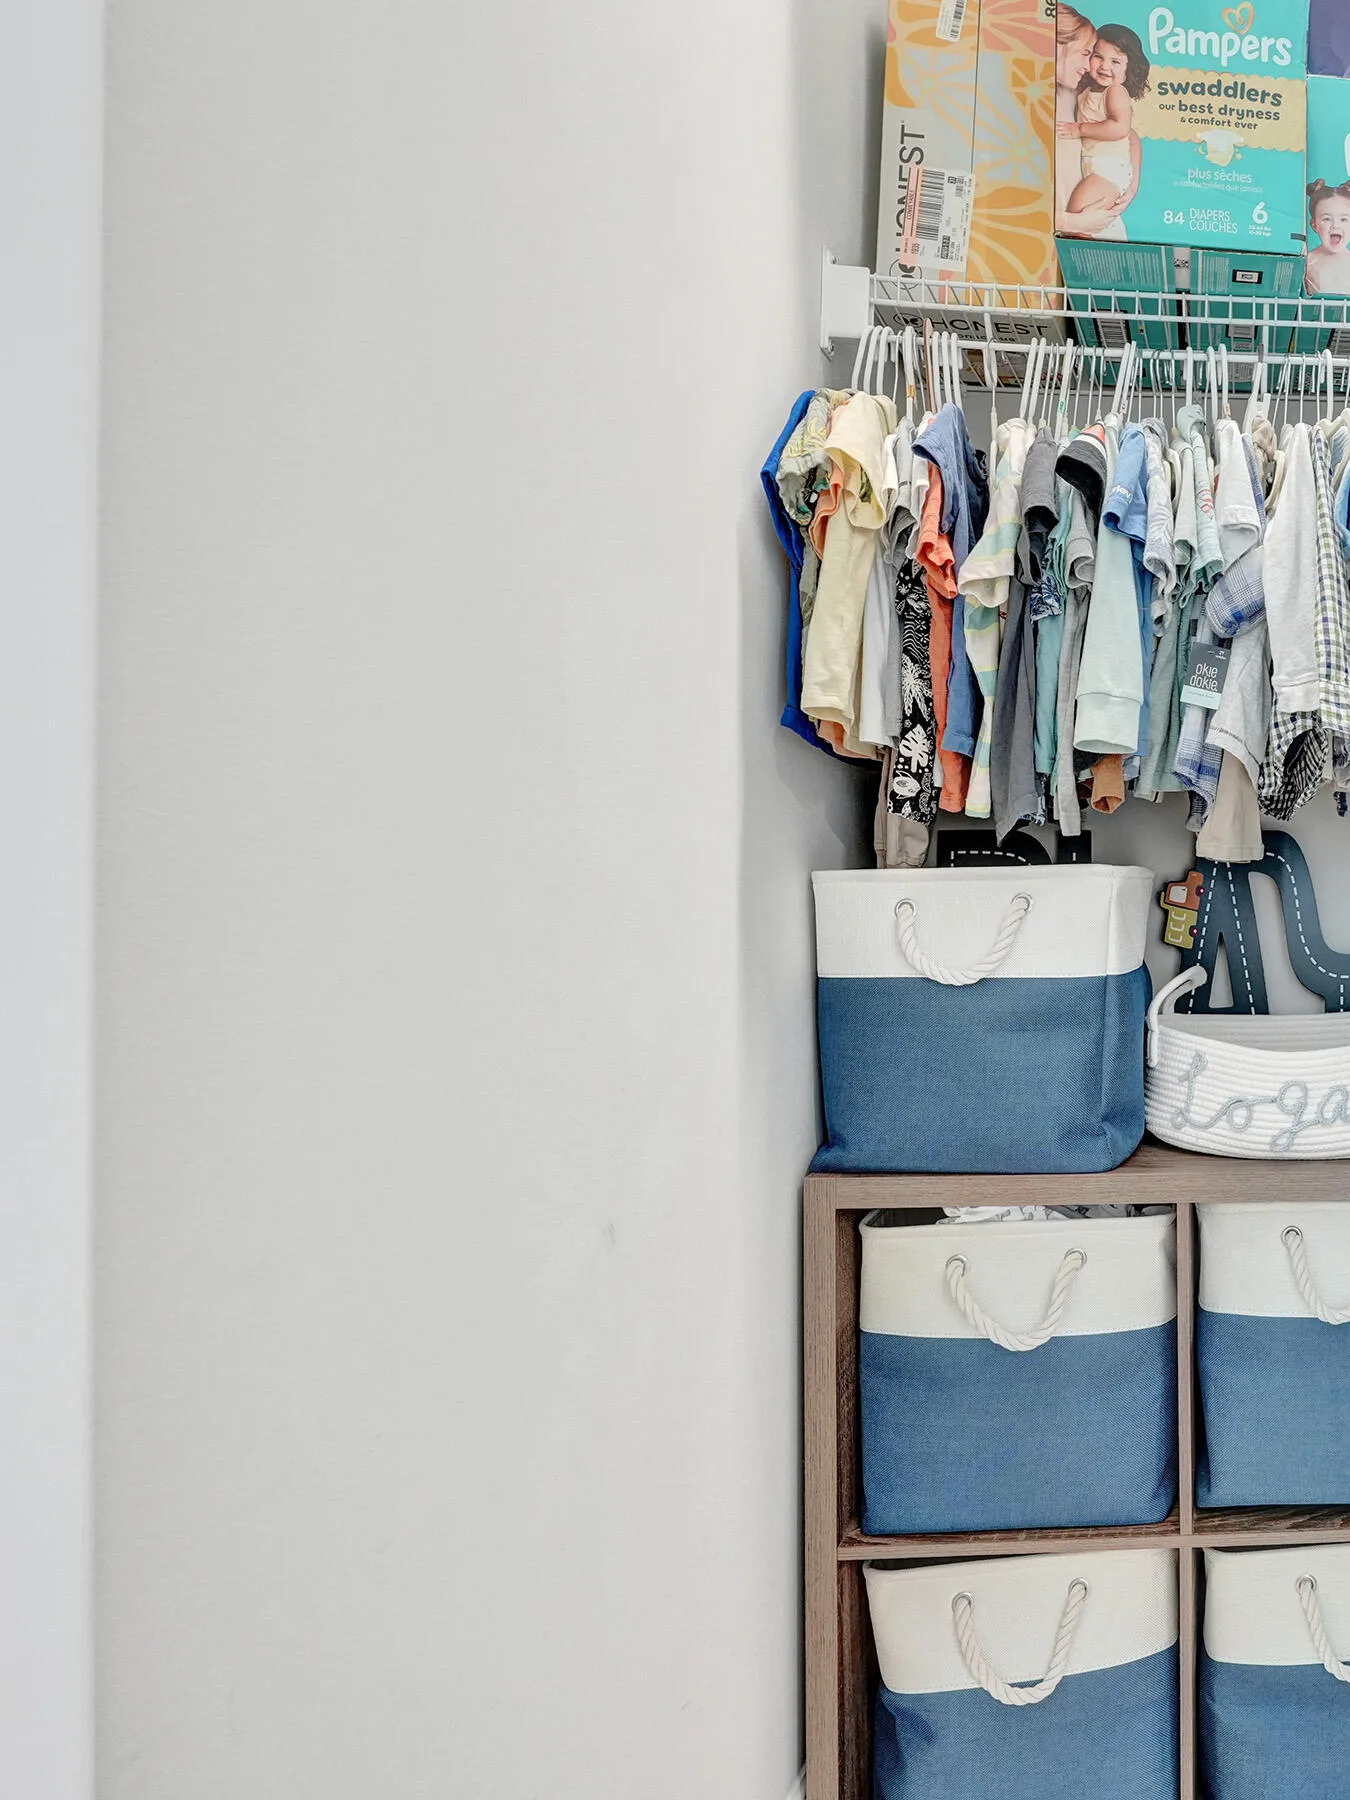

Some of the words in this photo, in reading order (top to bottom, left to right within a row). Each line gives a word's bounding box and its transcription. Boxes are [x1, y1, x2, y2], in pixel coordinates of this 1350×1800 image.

[1148, 7, 1293, 67] Pampers
[1157, 79, 1283, 107] swaddlers
[1158, 103, 1176, 111] our
[1178, 100, 1213, 114] best
[1218, 104, 1281, 121] dryness
[1188, 116, 1231, 127] comfort
[1234, 121, 1258, 130] ever
[1187, 168, 1212, 181] plus
[1214, 168, 1253, 184] sèches
[1163, 210, 1185, 225] 84
[1189, 208, 1231, 222] DIAPERS
[1251, 201, 1269, 224] 6
[1189, 220, 1239, 234] COUCHES
[931, 317, 1051, 336] HONEST
[1195, 662, 1218, 678] okie
